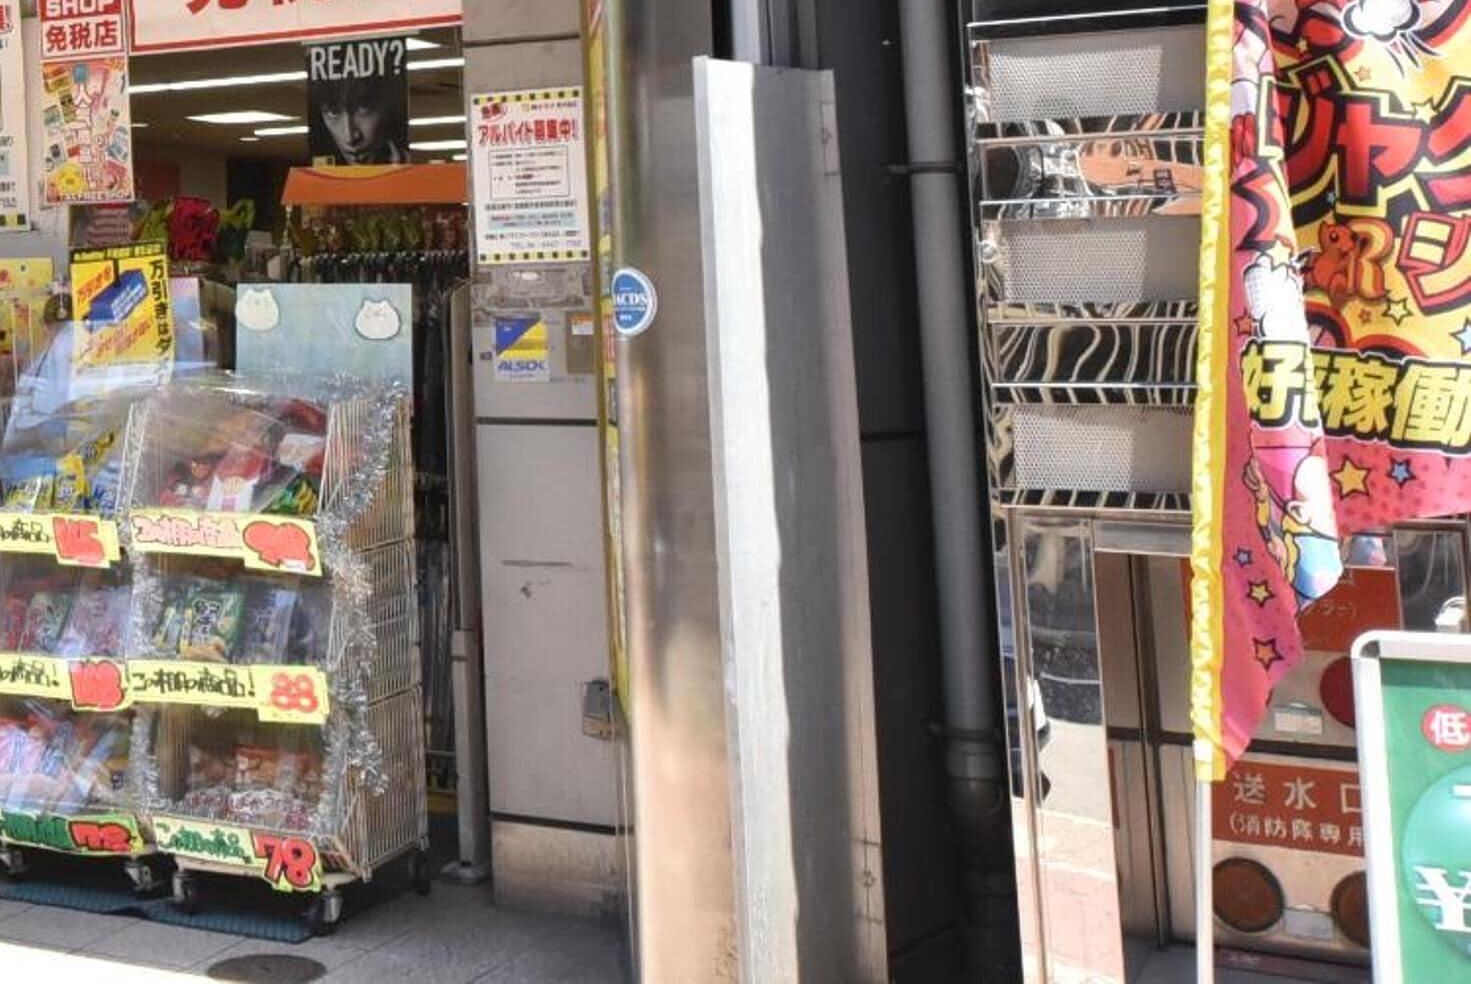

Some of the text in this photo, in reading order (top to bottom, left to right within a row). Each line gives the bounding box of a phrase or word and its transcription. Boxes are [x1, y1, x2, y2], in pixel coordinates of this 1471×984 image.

[46, 19, 118, 53] 免税店
[310, 40, 404, 81] READY?
[271, 672, 319, 713] 88
[254, 834, 316, 888] 78
